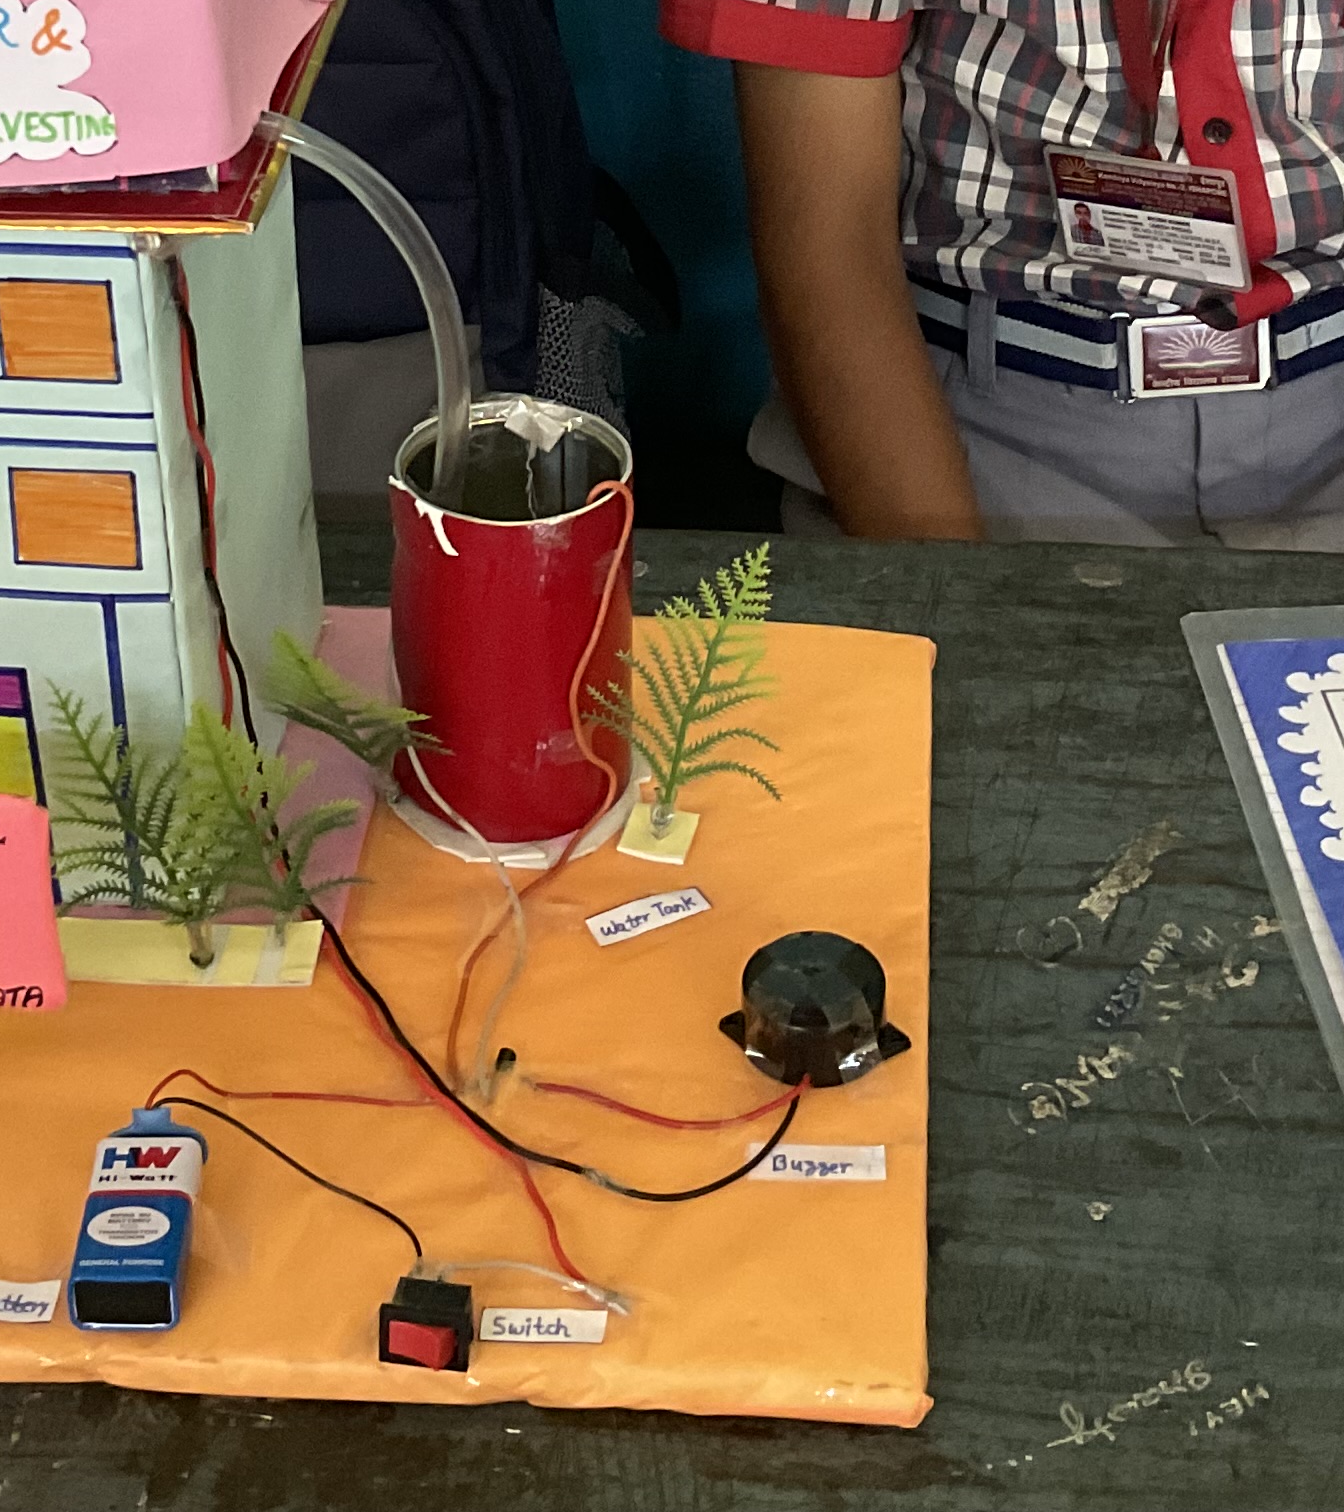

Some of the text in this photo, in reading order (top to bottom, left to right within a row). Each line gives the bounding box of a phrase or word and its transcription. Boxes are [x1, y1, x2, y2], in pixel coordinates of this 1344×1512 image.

[31, 7, 73, 56] &
[651, 896, 697, 917] Tank
[101, 1146, 182, 1170] HW
[771, 1154, 853, 1177] Buzzer
[492, 1316, 572, 1338] Switch
